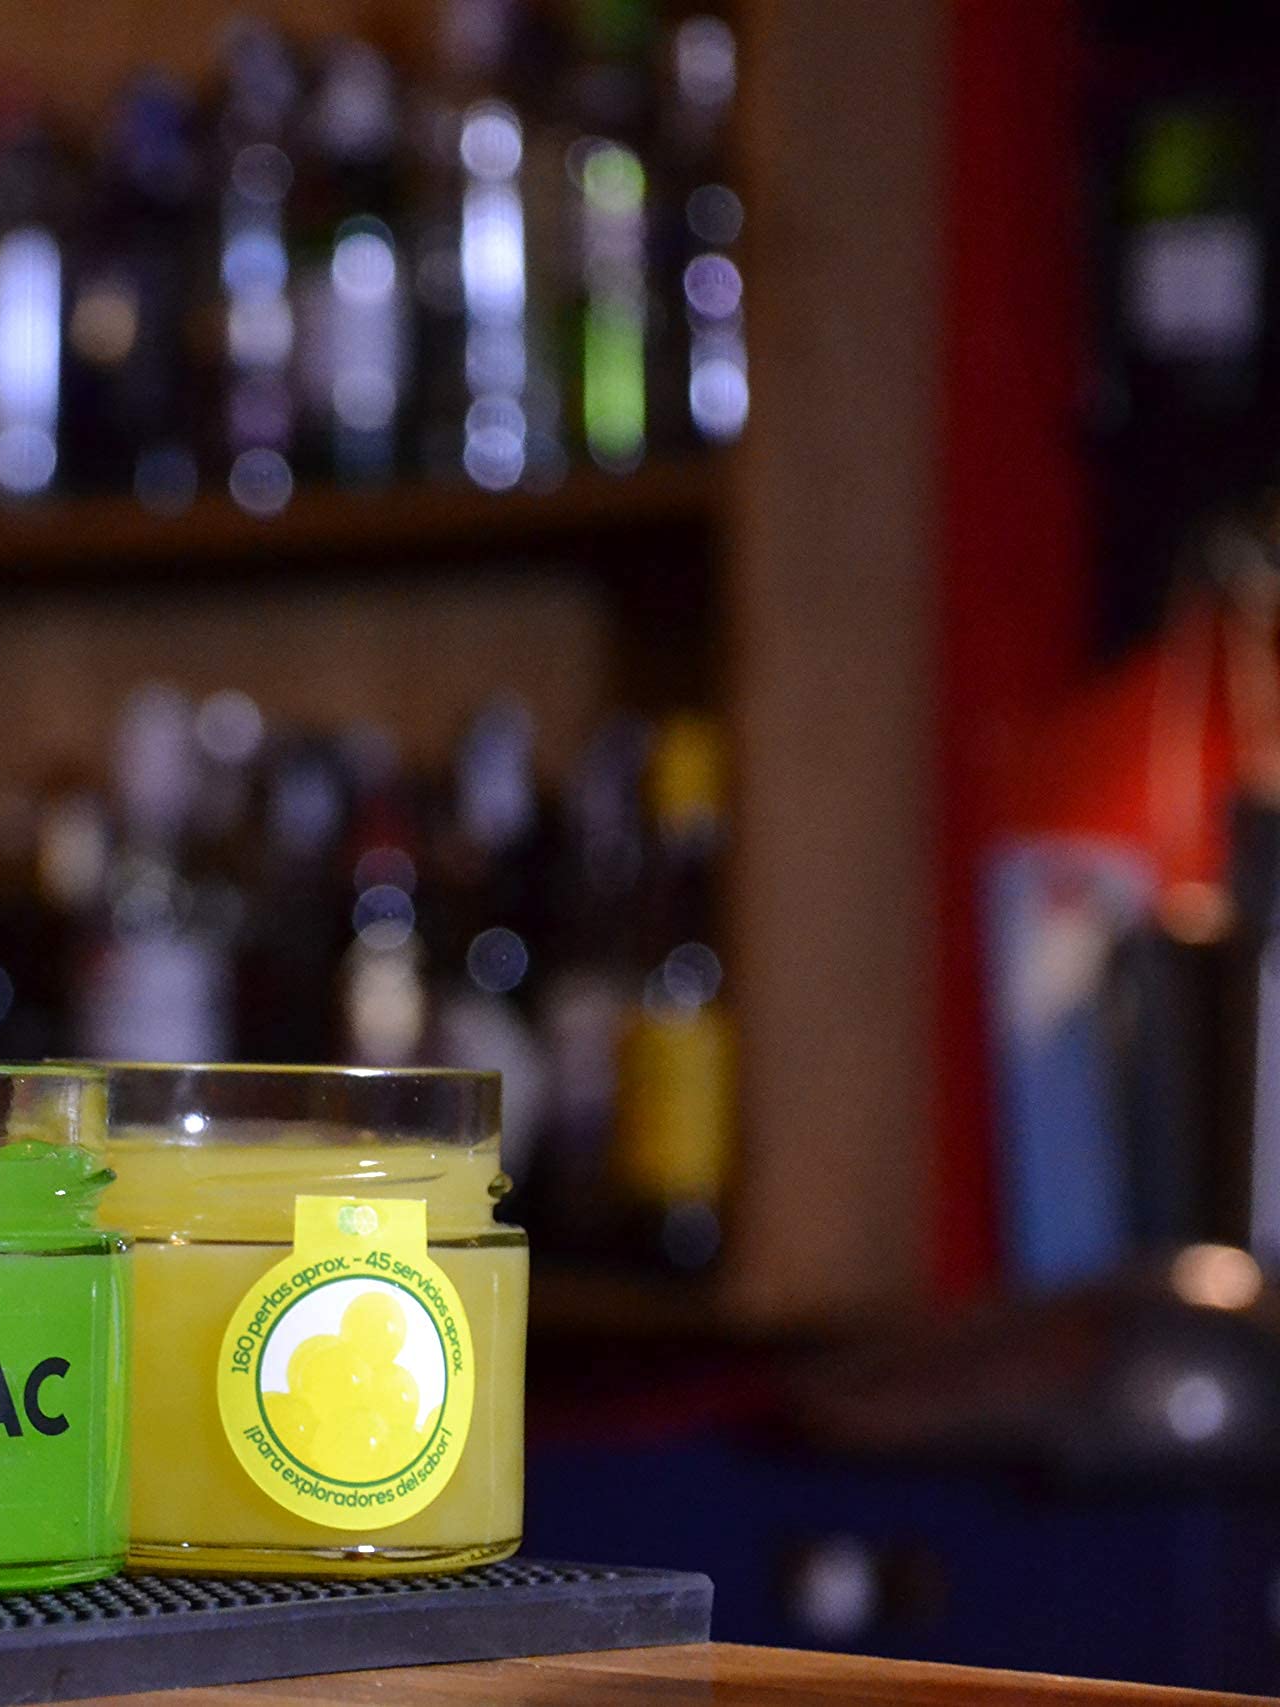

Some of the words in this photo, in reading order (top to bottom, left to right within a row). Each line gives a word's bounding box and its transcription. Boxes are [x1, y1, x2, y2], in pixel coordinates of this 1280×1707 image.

[231, 1335, 256, 1375] 160
[247, 1280, 294, 1337] perlas
[291, 1256, 350, 1288] aprox.
[365, 1251, 392, 1271] 45
[392, 1261, 449, 1318] servicios
[443, 1316, 464, 1377] aprox.
[281, 1468, 396, 1508] exploradores
[396, 1470, 420, 1498] del
